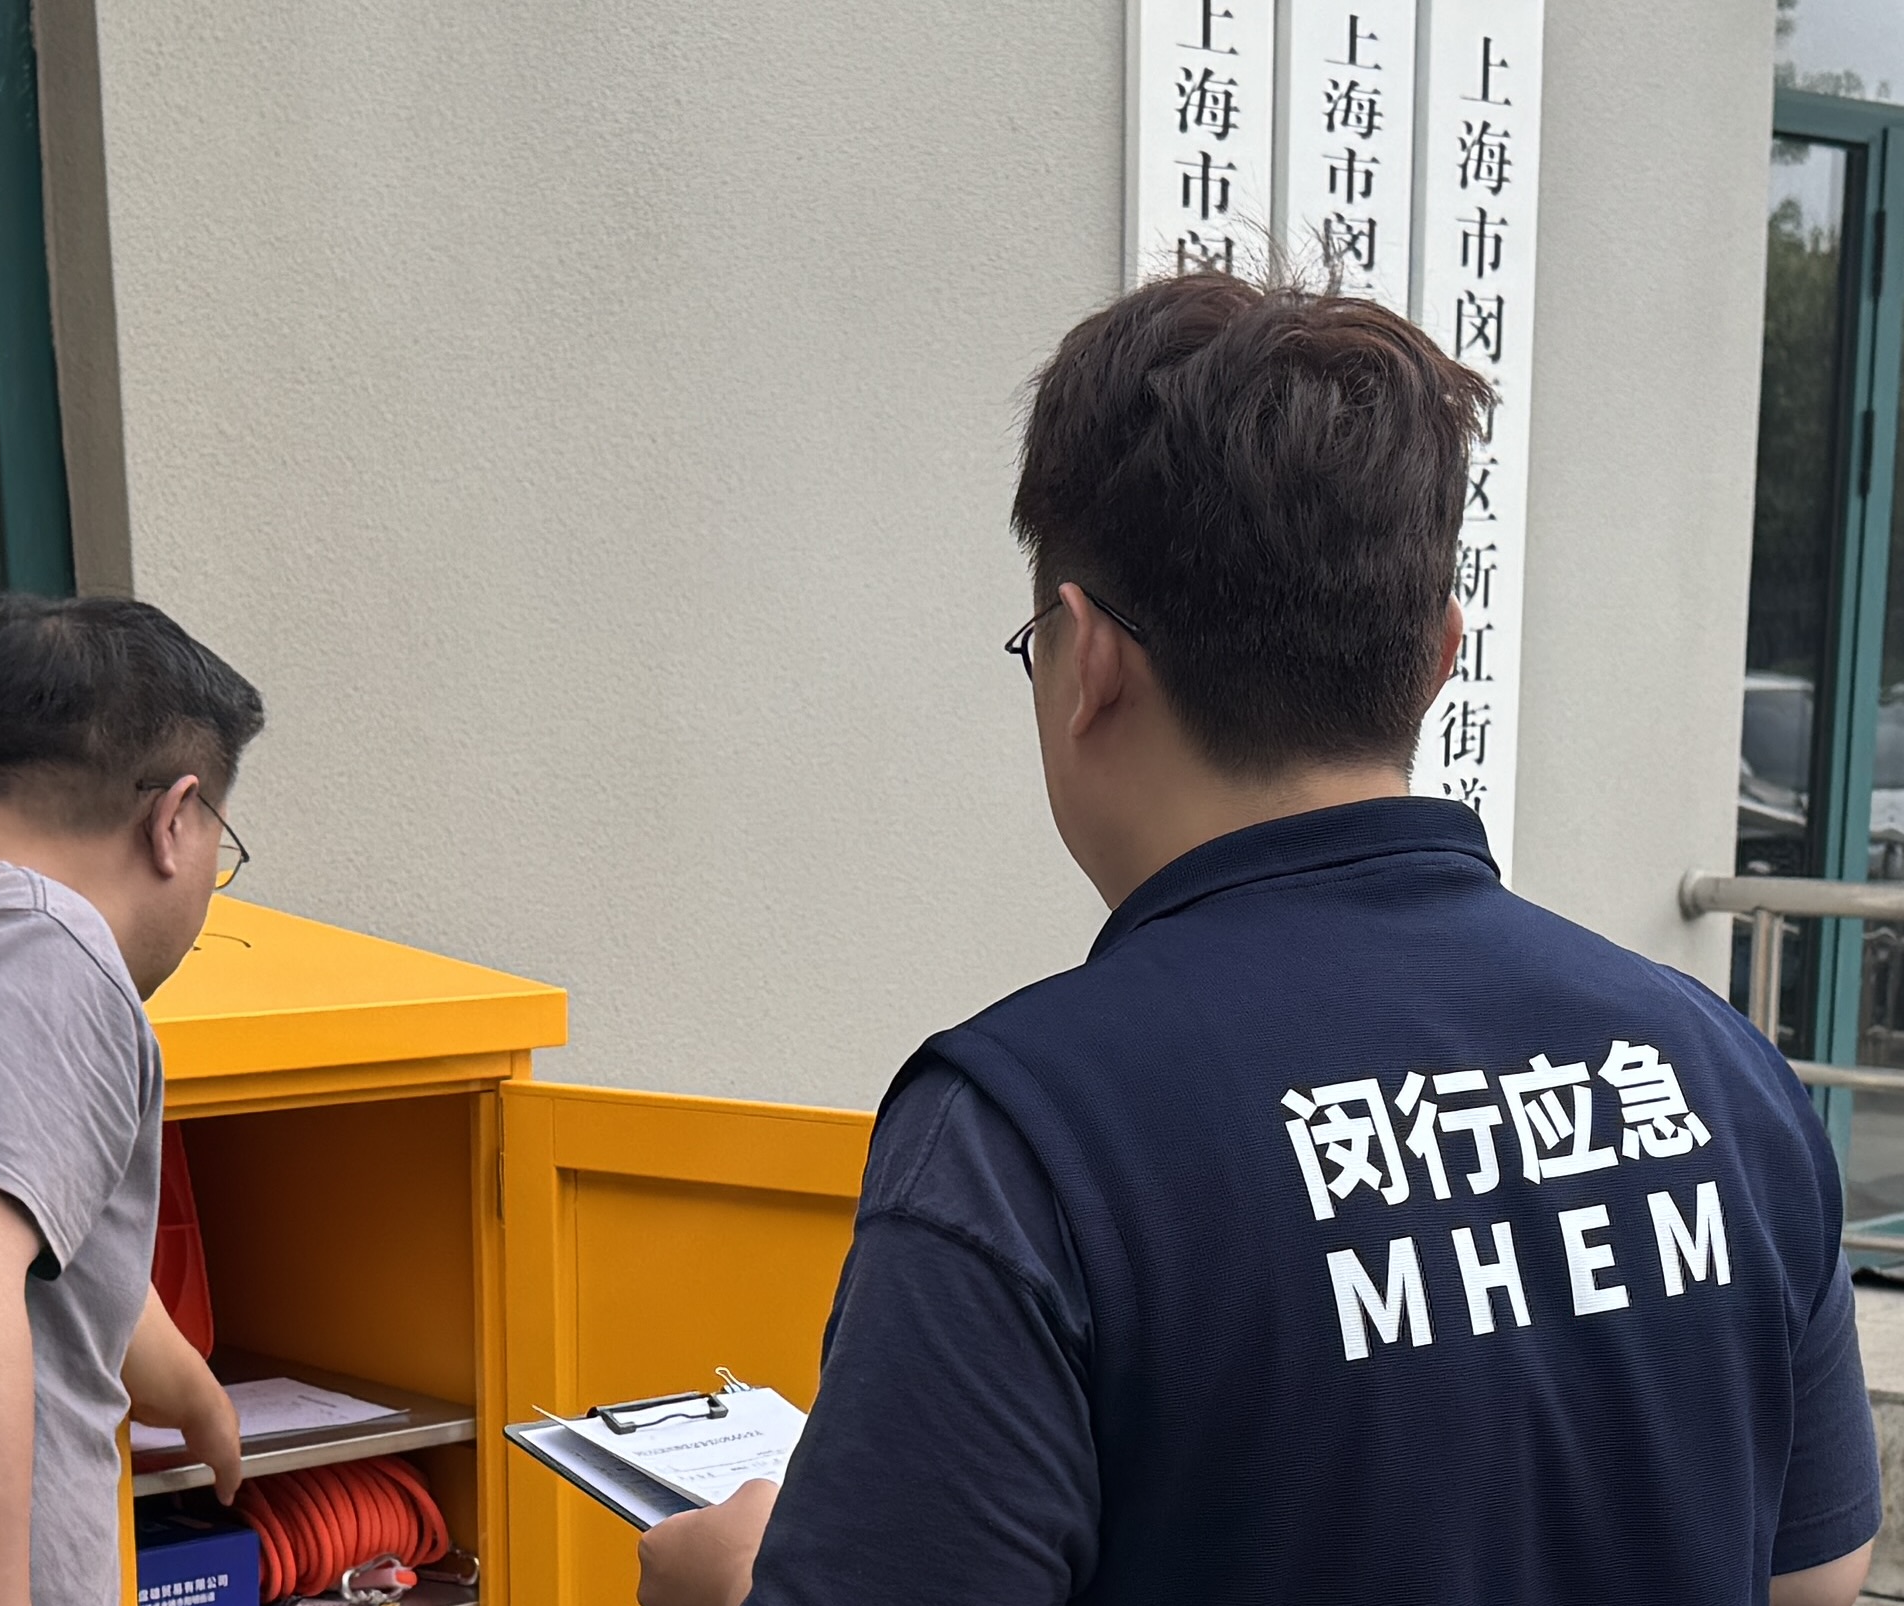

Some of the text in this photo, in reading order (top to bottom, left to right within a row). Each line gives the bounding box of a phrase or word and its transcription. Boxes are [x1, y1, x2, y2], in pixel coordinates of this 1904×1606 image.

[1323, 14, 1384, 289] 上海市闵
[1281, 1040, 1712, 1221] 闵行应急
[1326, 1181, 1732, 1362] MHEM
